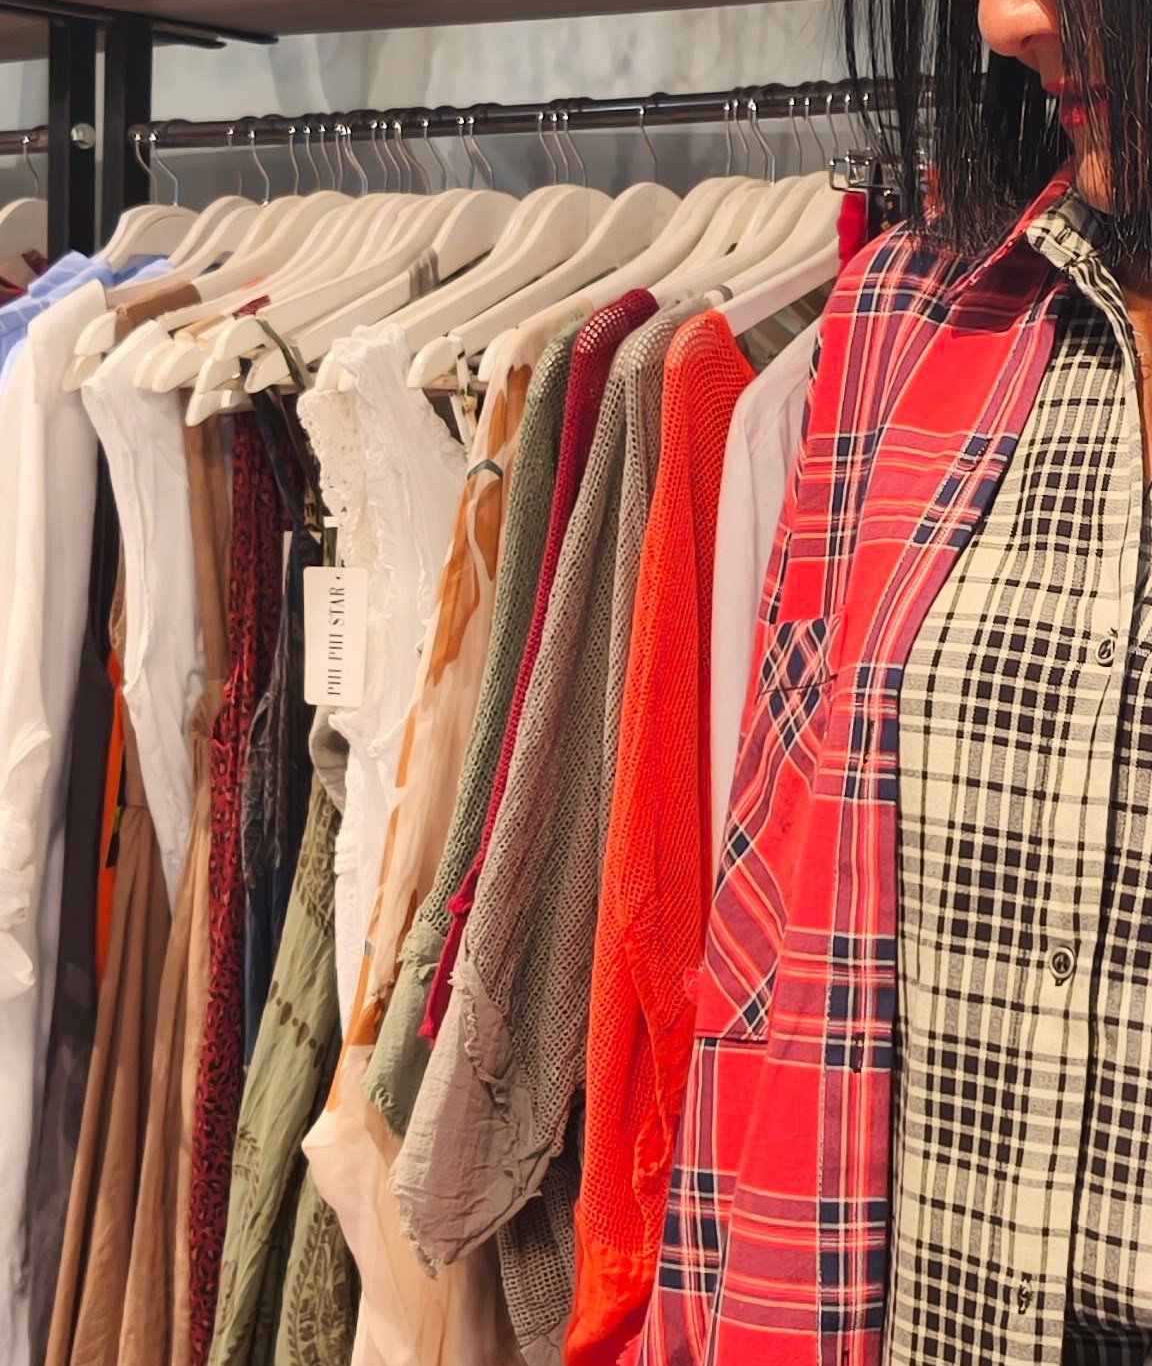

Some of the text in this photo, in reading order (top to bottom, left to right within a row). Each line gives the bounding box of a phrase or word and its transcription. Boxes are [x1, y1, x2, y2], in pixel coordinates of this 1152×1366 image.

[327, 587, 345, 696] PHI PHI STAR
